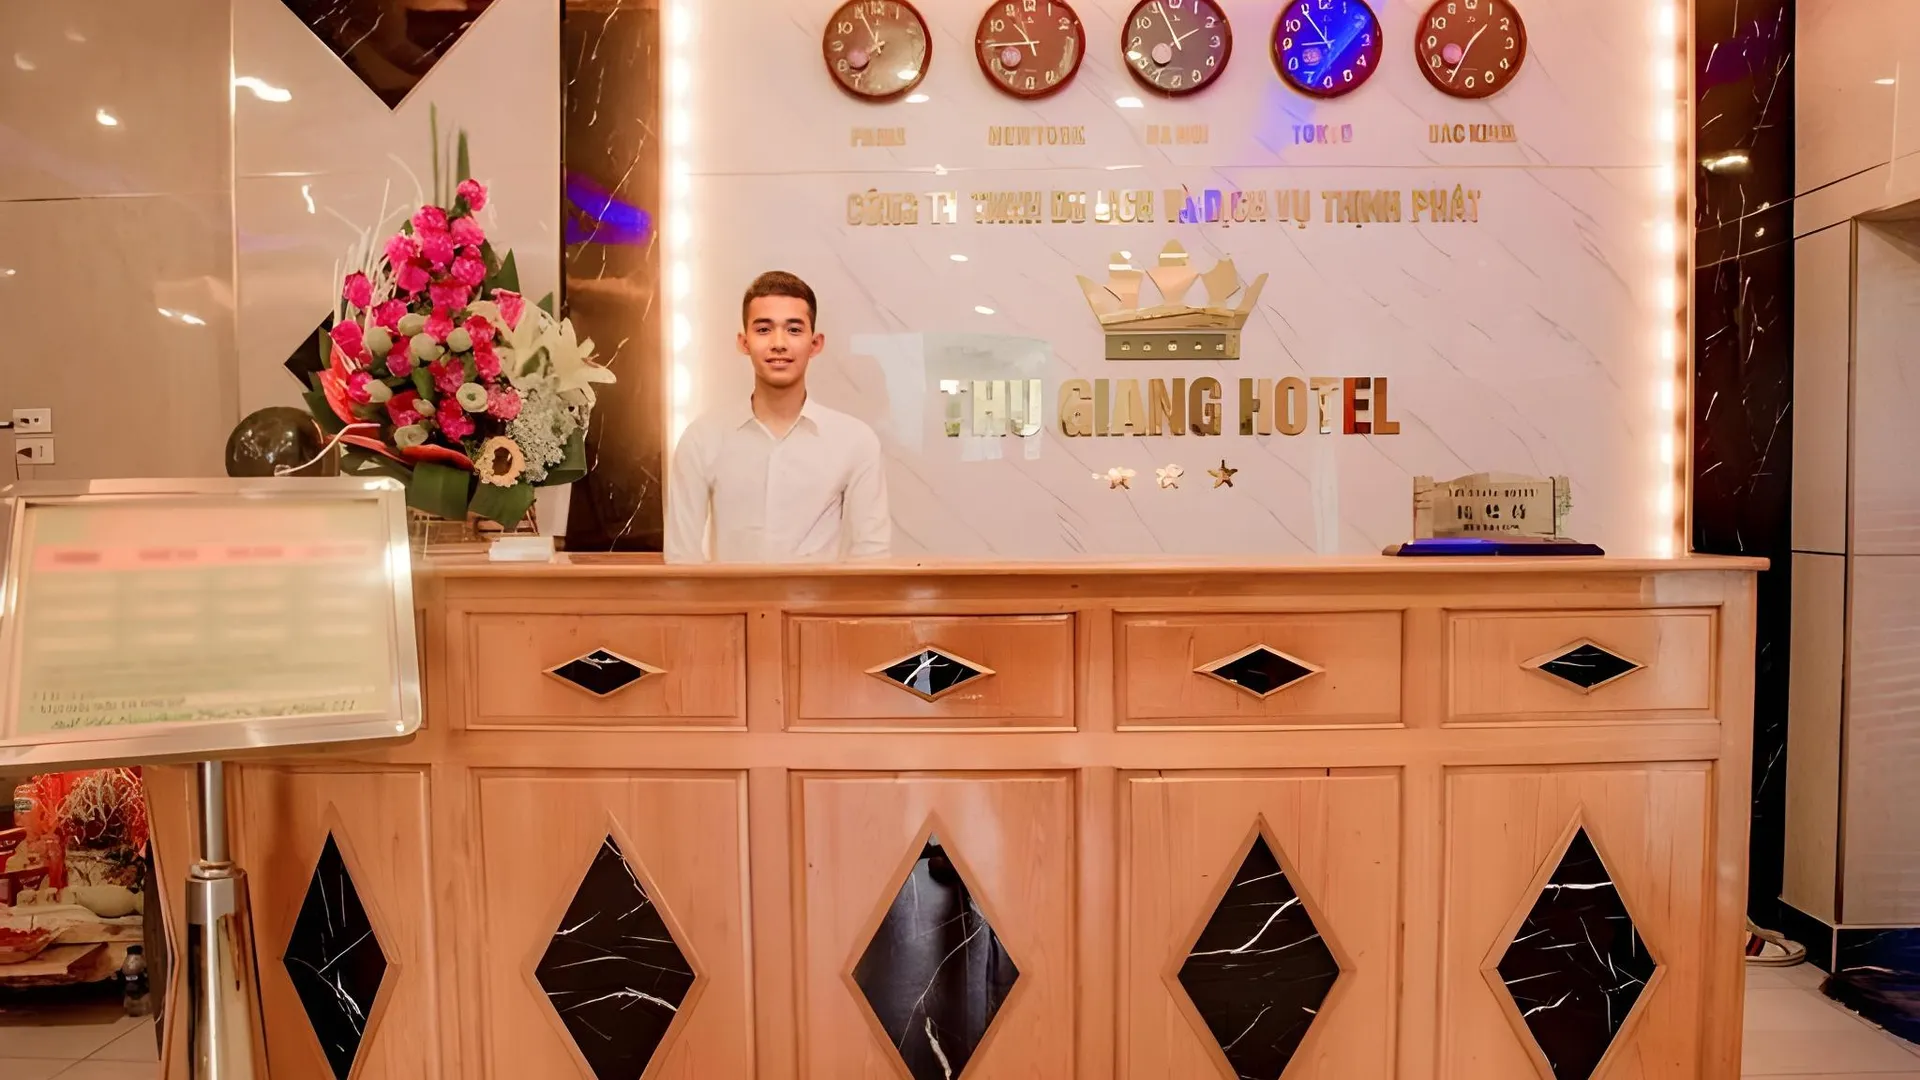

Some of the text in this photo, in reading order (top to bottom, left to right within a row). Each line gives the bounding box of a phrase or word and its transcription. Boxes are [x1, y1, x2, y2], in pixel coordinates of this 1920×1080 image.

[838, 21, 853, 34] 10
[990, 19, 1005, 32] 10
[1136, 16, 1151, 29] 10
[1204, 16, 1215, 28] 2
[1285, 19, 1301, 32] 10
[1431, 17, 1446, 29] 10
[1209, 35, 1220, 48] 3
[1057, 377, 1222, 437] GIANG
[1239, 376, 1400, 436] HOTEL
